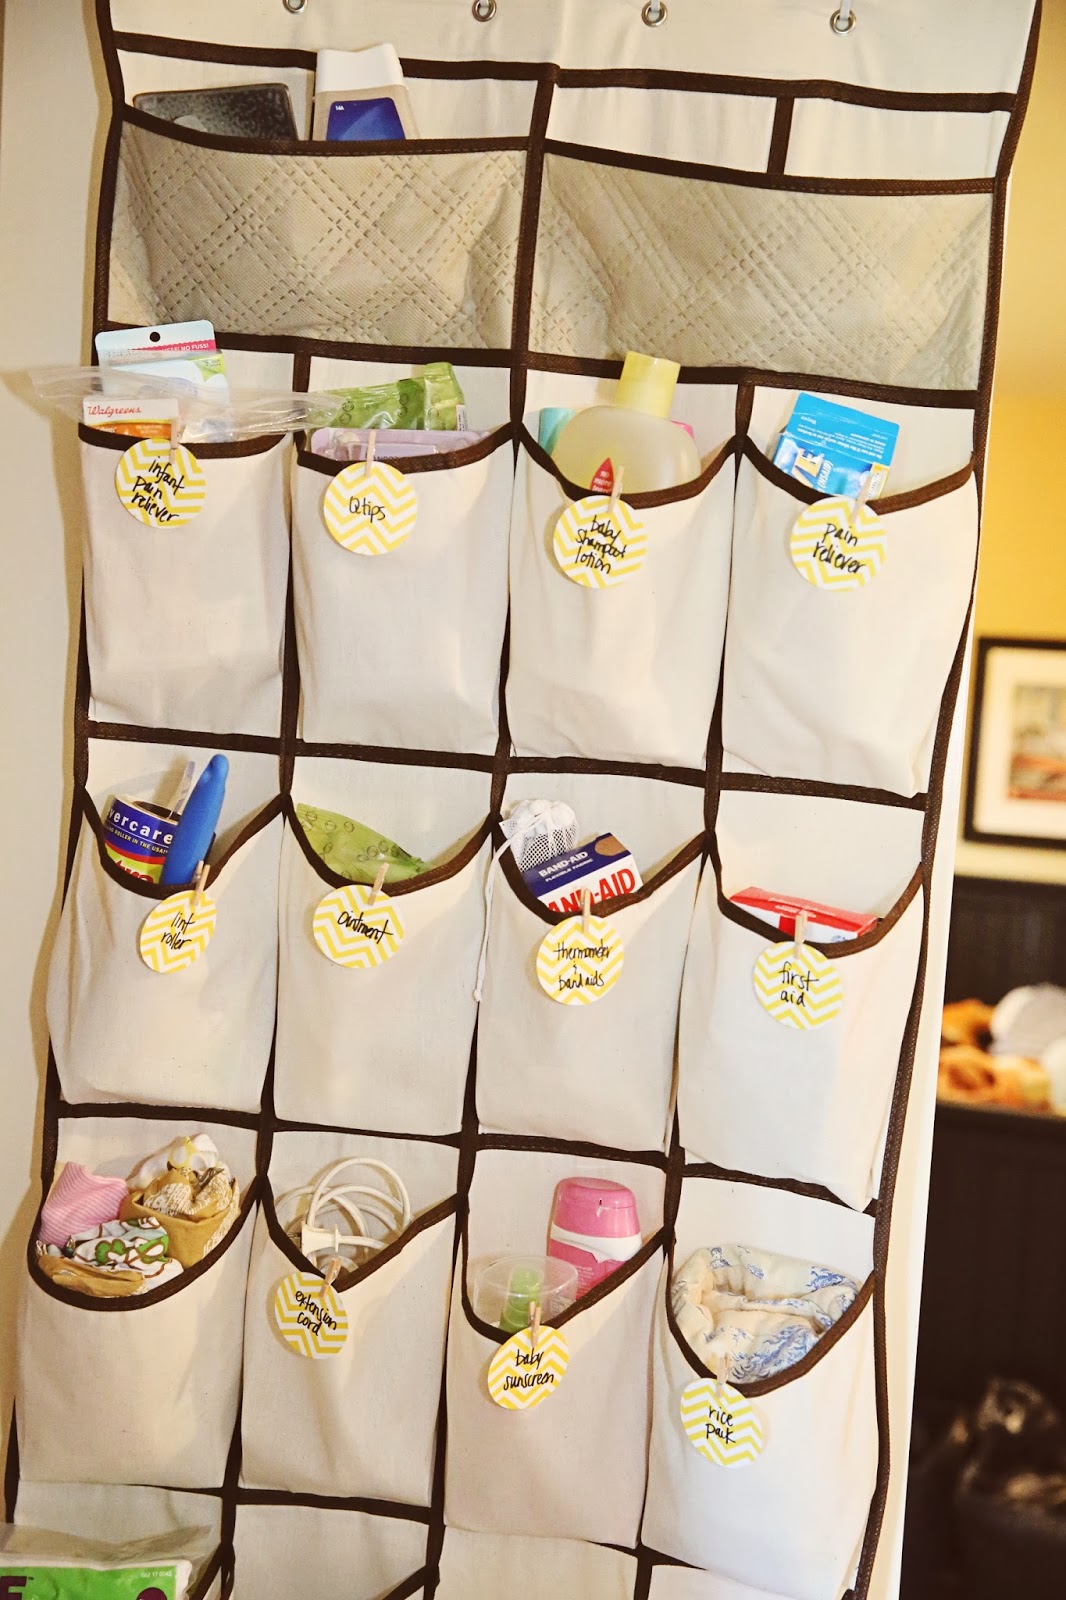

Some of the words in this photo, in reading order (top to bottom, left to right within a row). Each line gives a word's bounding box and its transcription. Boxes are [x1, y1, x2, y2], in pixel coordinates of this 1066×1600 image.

[88, 406, 142, 418] Walgreens
[148, 456, 185, 496] infant
[818, 460, 834, 487] (NSAID)
[131, 491, 180, 523] reliever
[349, 496, 386, 523] Qtips
[590, 514, 622, 545] baby
[574, 546, 611, 574] lotion
[812, 541, 866, 574] reliever
[108, 808, 174, 844] vercare
[114, 830, 132, 842] ROLLER
[140, 842, 150, 850] THE
[538, 851, 588, 878] BAND-AID
[545, 868, 572, 882] FLEXIBLE
[172, 912, 196, 934] lint
[160, 932, 192, 950] roller
[778, 962, 820, 991] first
[780, 990, 806, 1008] aid
[296, 1291, 337, 1330] extension
[296, 1312, 322, 1336] cord
[515, 1349, 544, 1370] baby
[503, 1372, 554, 1391] sunscreen
[708, 1406, 734, 1426] rice
